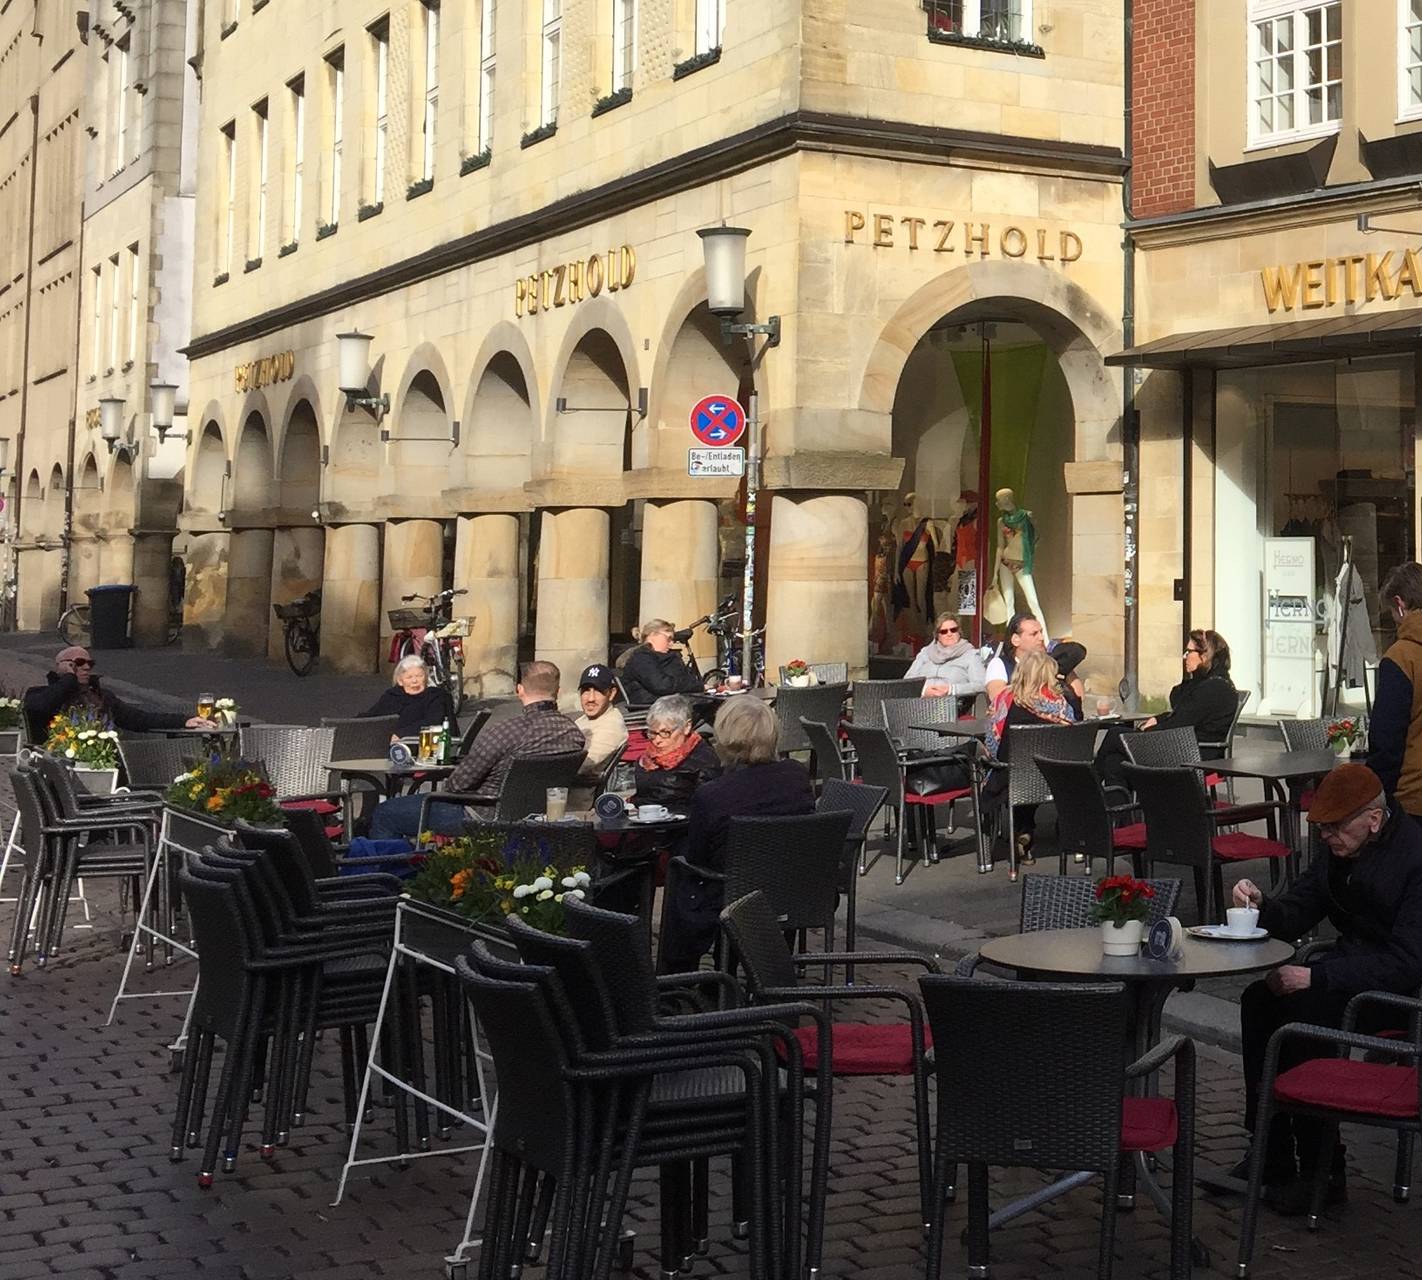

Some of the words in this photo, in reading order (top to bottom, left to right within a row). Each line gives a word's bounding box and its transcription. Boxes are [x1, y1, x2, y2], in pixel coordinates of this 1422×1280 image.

[844, 210, 1083, 262] PETZHOLD
[515, 245, 637, 318] PETZHOLD
[691, 451, 741, 461] Be-/Entladen
[702, 464, 730, 473] erlaubt
